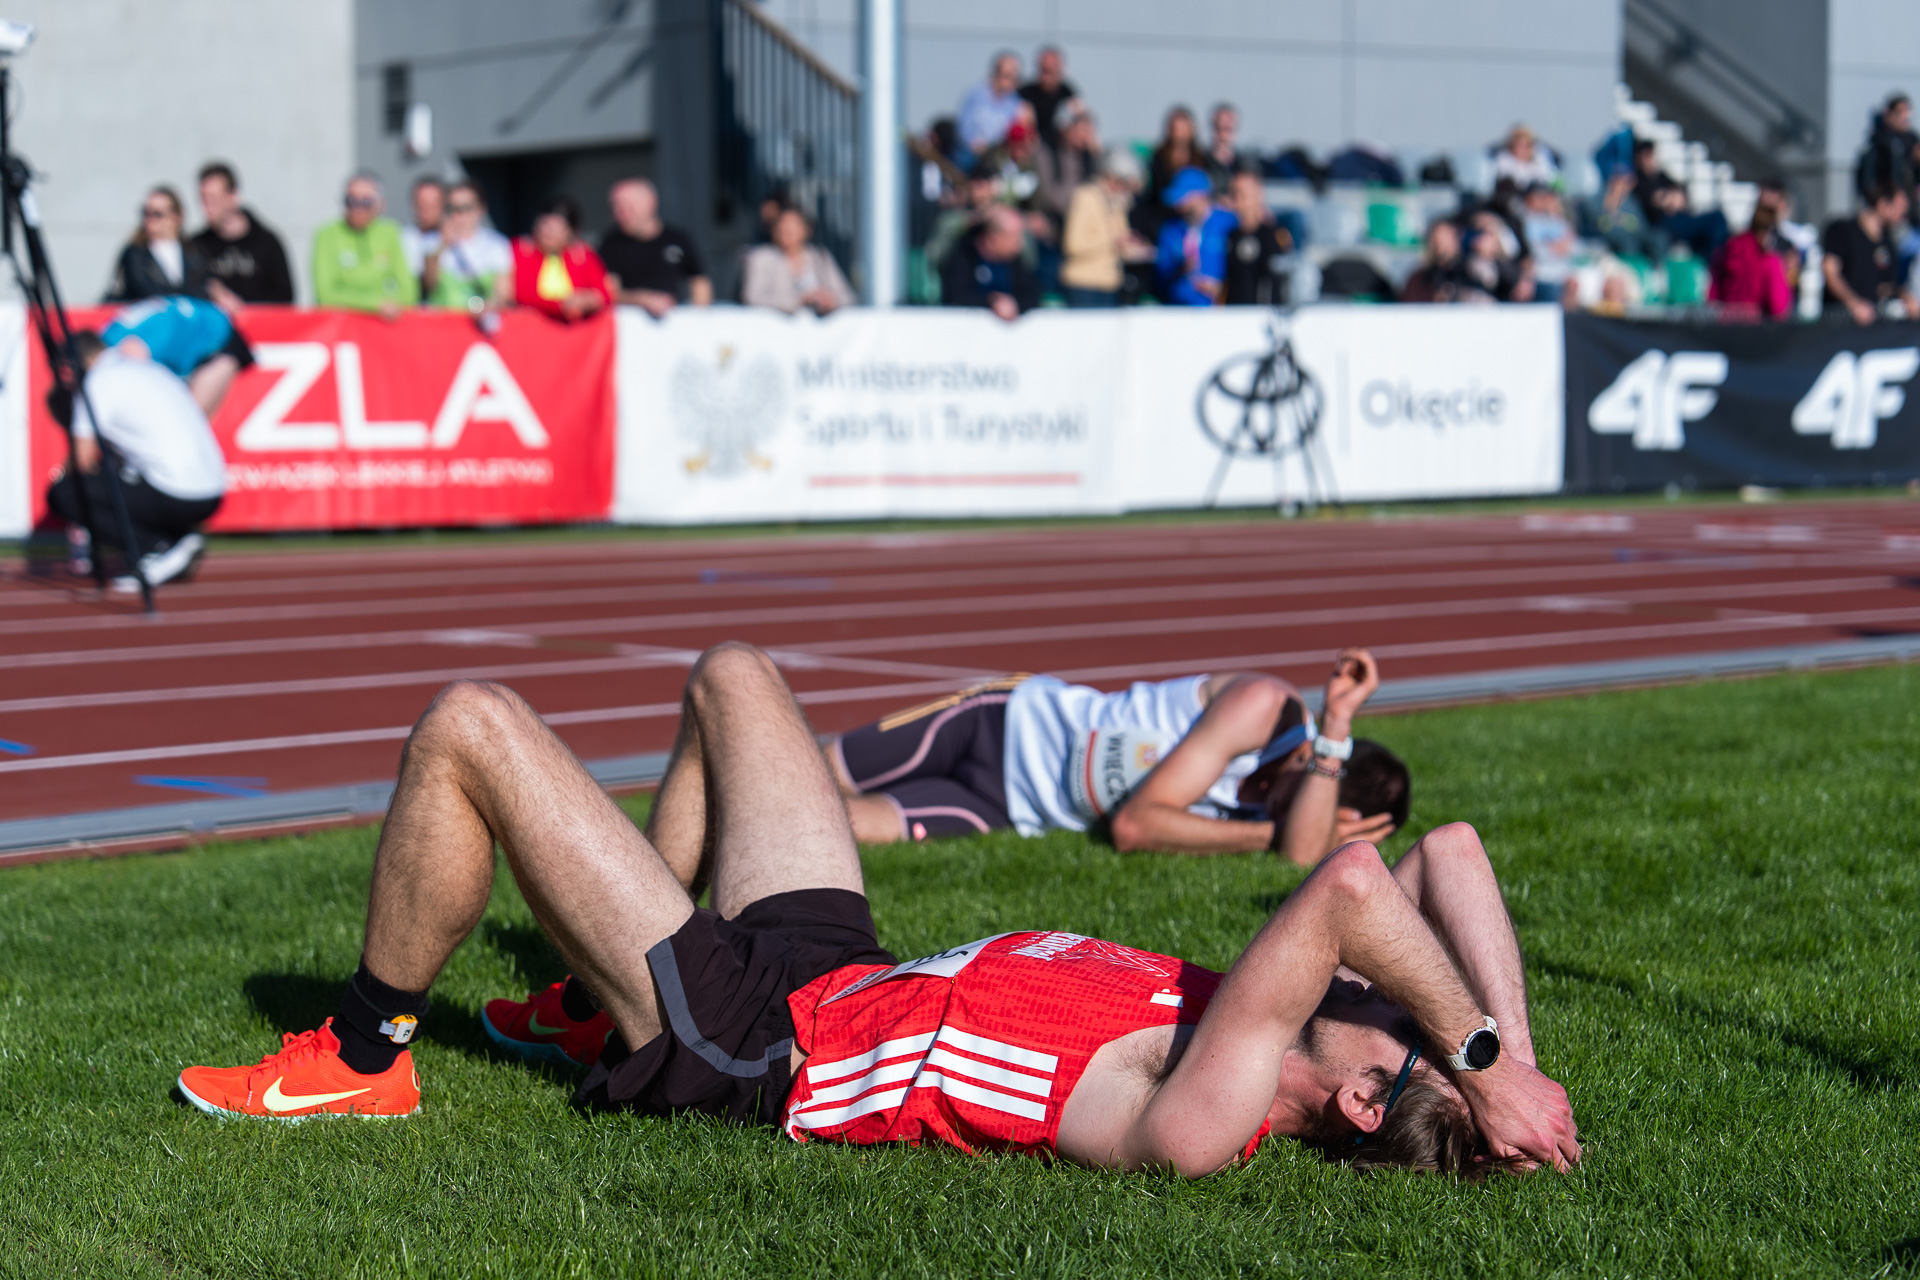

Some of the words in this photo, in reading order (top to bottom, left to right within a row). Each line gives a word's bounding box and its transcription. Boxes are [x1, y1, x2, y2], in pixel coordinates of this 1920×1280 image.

[795, 355, 1018, 391] Ministerstwo
[1588, 348, 1729, 451] 4F
[1791, 346, 1919, 450] 4F
[943, 405, 1086, 446] Turystyki
